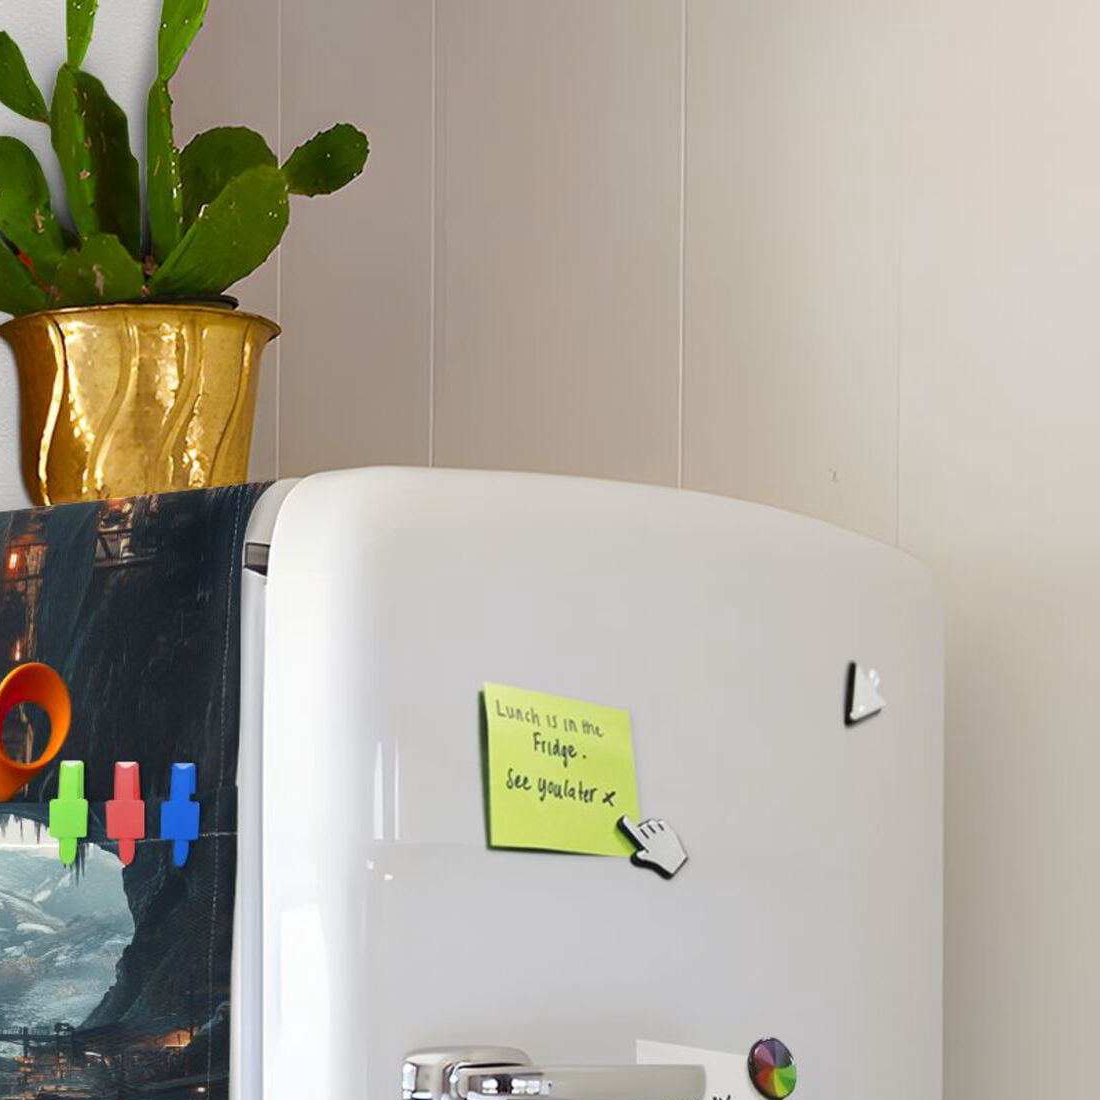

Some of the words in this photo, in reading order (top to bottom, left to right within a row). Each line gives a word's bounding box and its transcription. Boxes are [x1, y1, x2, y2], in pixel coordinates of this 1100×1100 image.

[495, 699, 541, 727] Lunch
[546, 714, 558, 729] is
[563, 718, 578, 733] in
[581, 720, 604, 738] the
[506, 767, 532, 791] See
